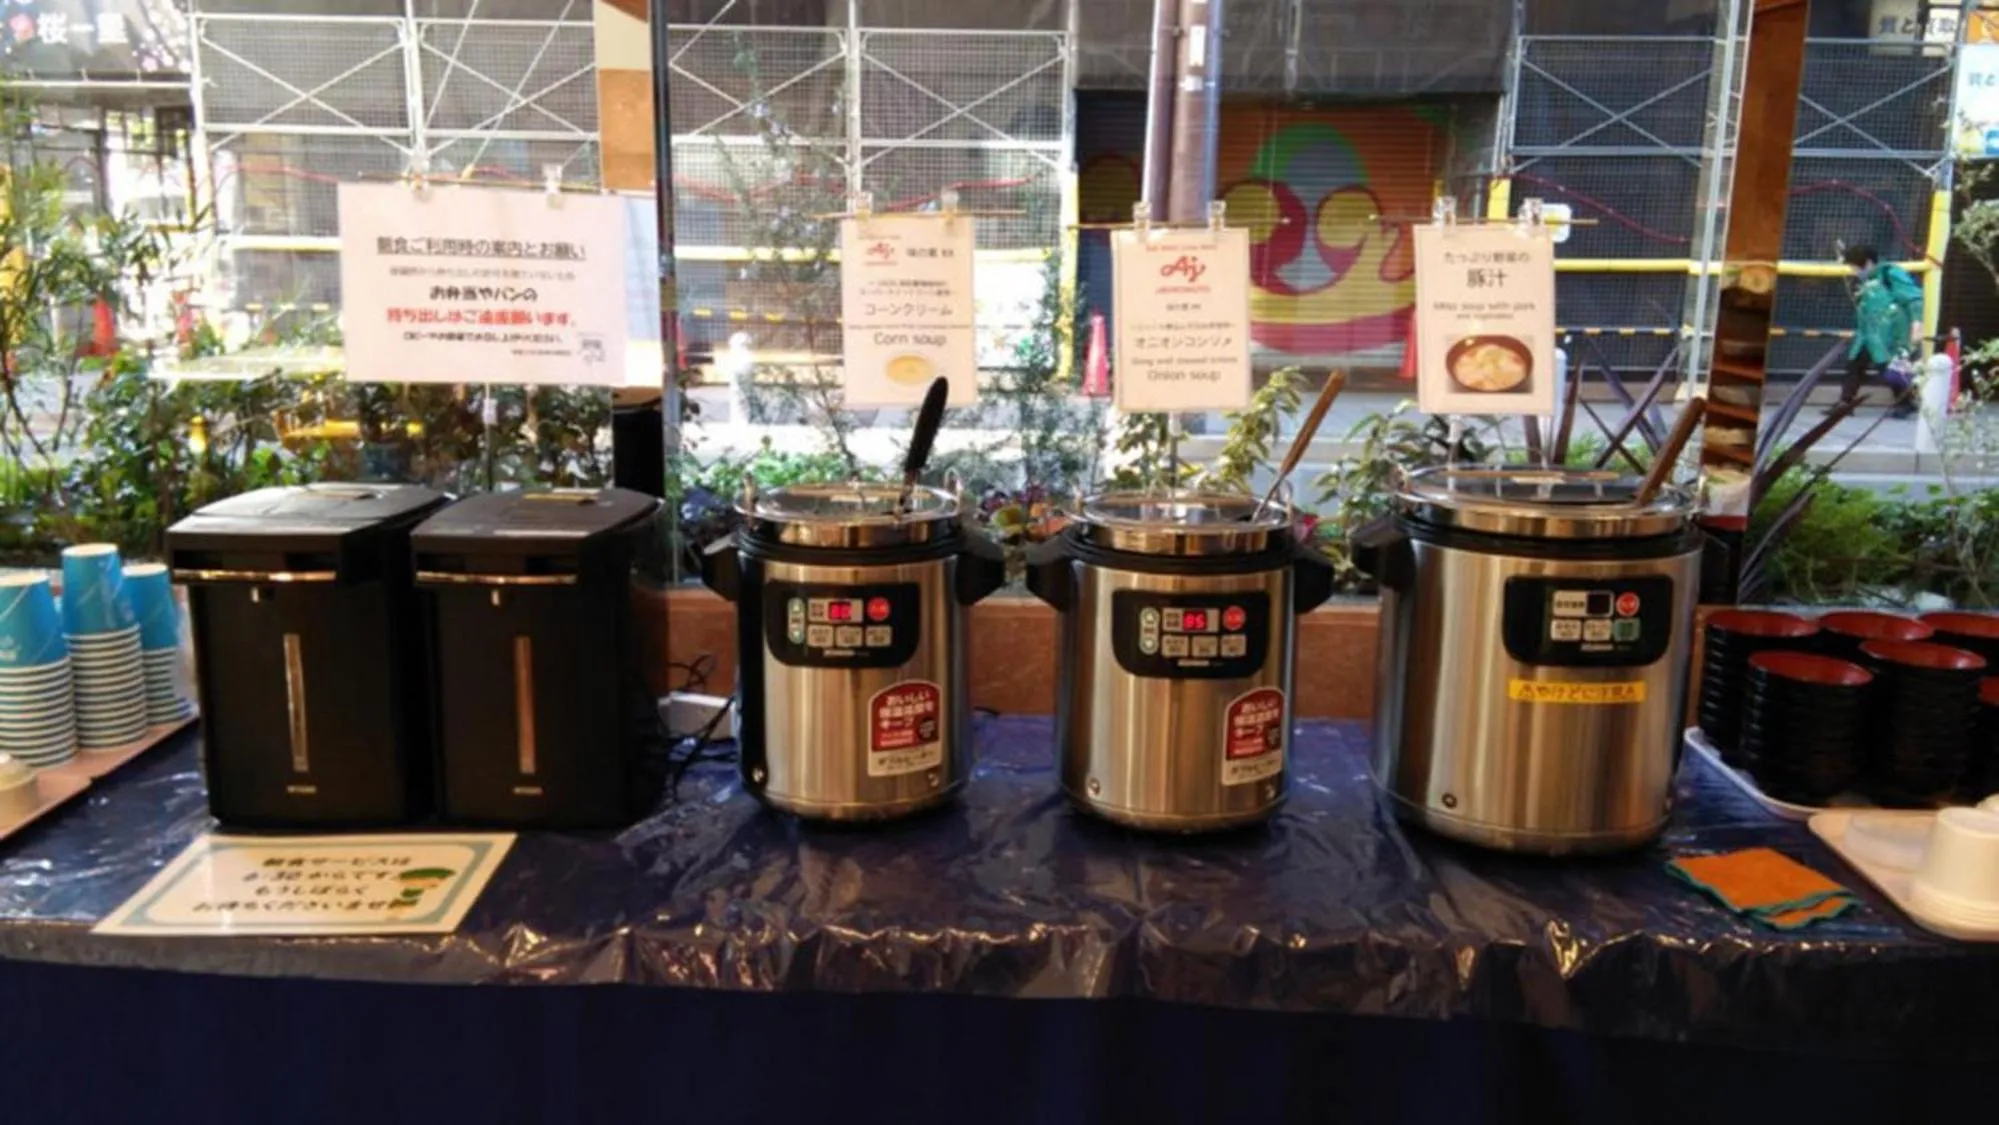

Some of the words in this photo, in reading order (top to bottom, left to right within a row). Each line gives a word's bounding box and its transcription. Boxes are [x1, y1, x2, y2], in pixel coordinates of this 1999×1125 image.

[1443, 251, 1531, 264] たっぷり野菜の
[1466, 268, 1508, 288] 豚汁
[429, 285, 539, 302] お弁当やパンの
[864, 303, 954, 316] コーンクリーム
[874, 332, 909, 345] Corn
[913, 334, 948, 346] soup
[1135, 336, 1233, 349] オニオンコンソメ
[1147, 369, 1186, 381] Onion
[1189, 370, 1221, 383] soup
